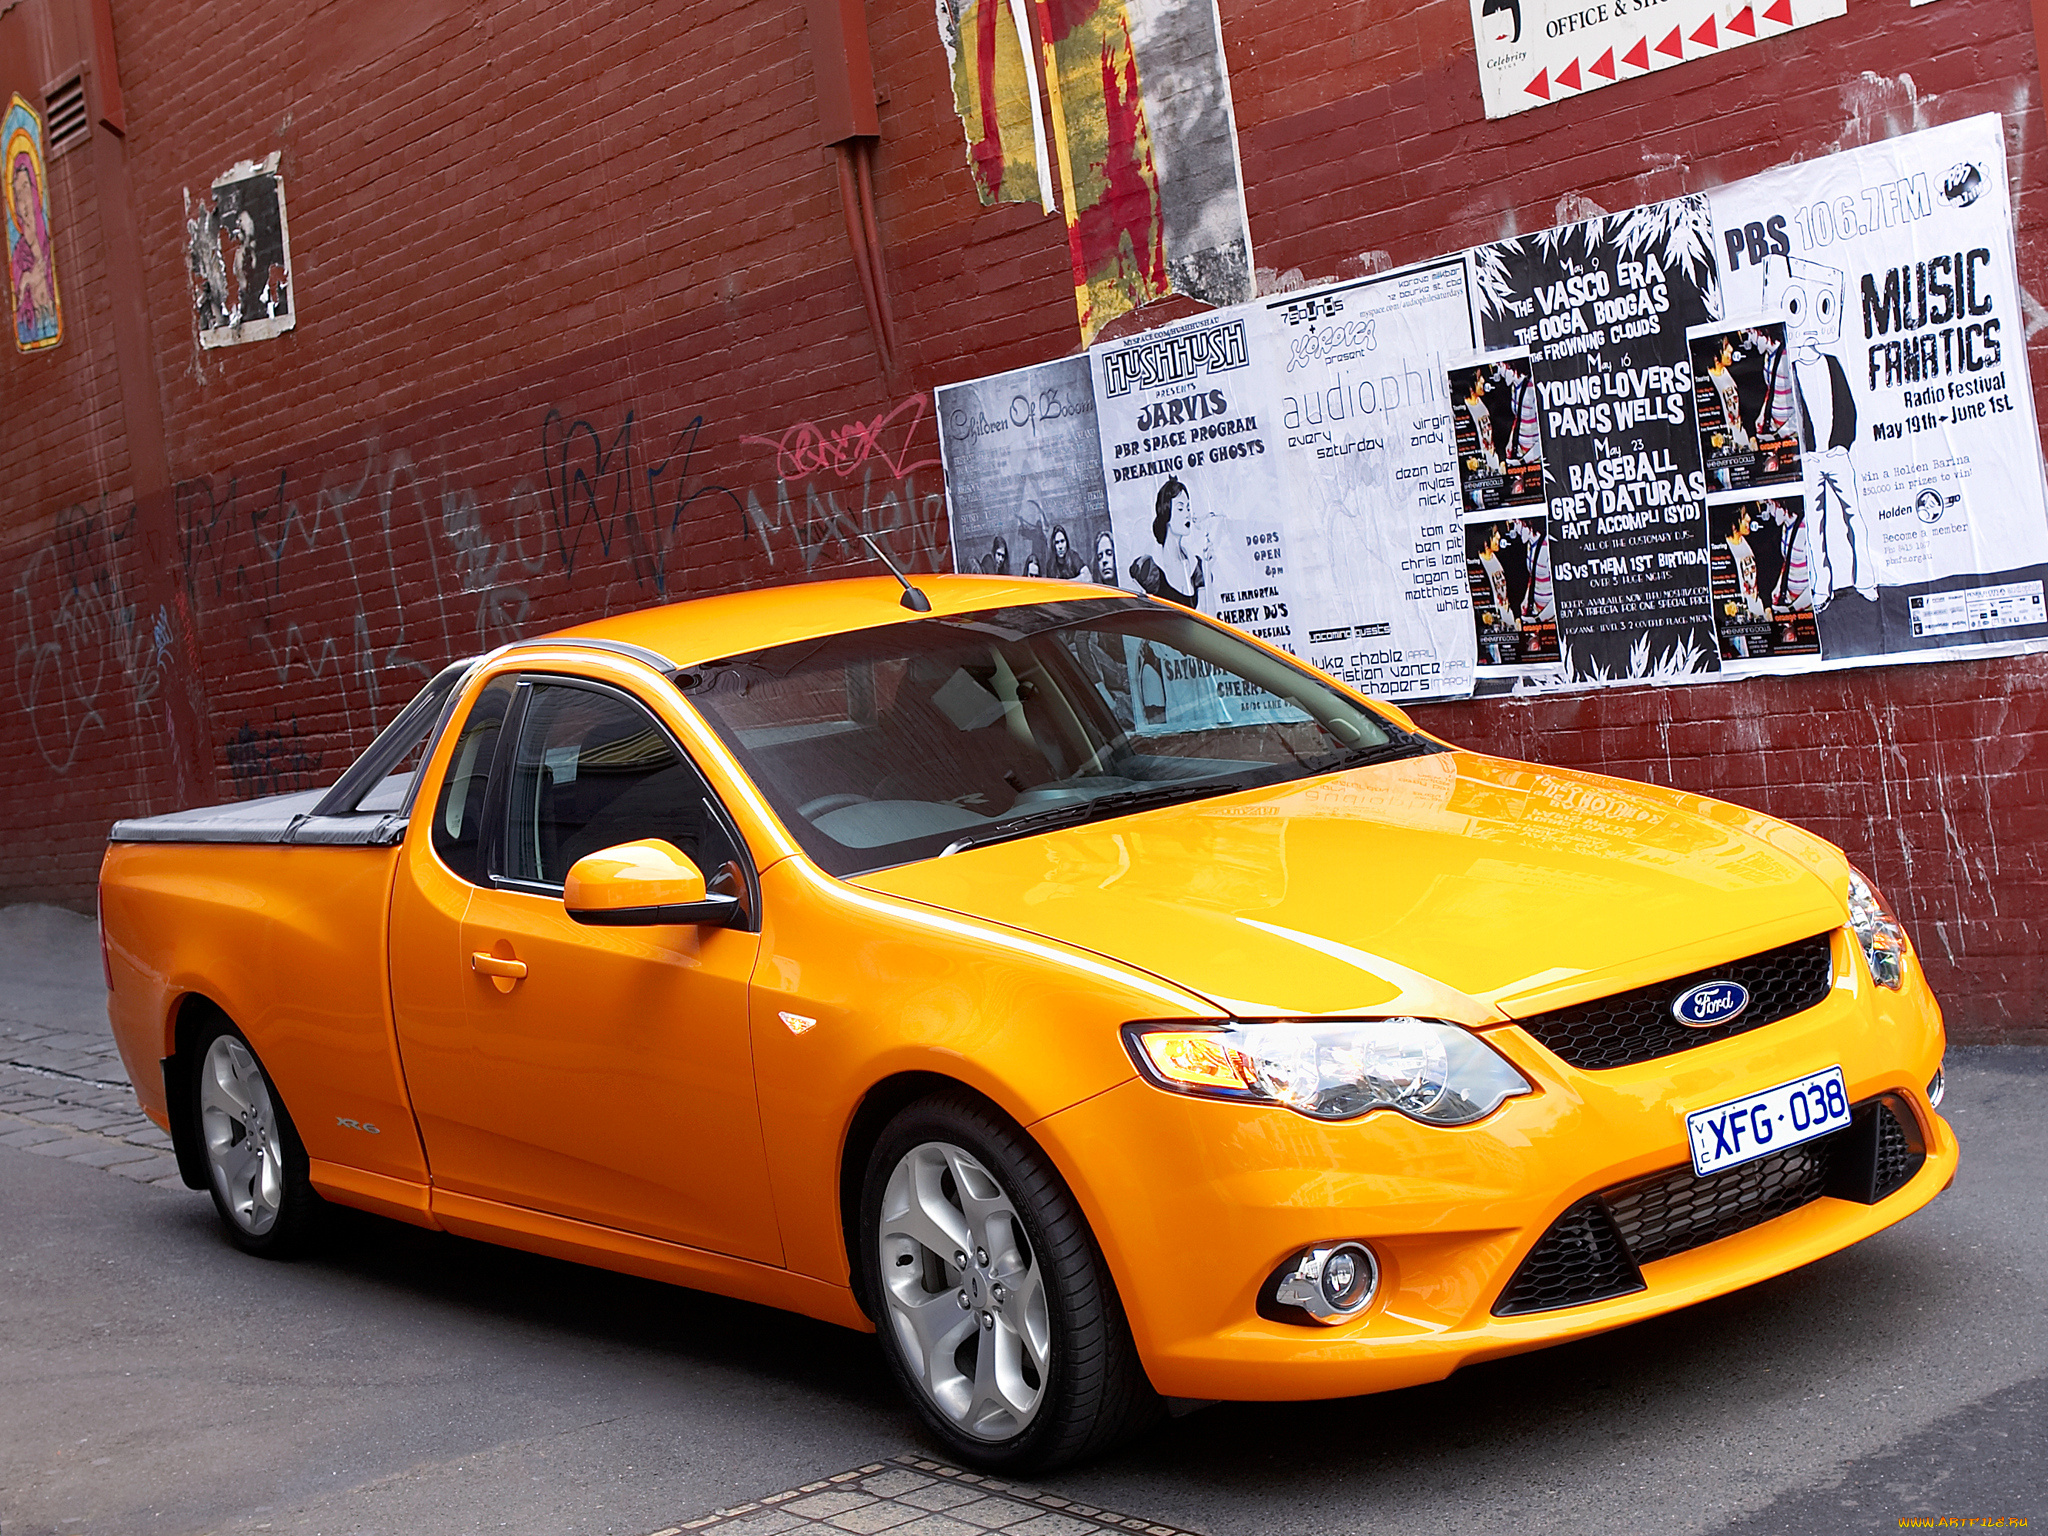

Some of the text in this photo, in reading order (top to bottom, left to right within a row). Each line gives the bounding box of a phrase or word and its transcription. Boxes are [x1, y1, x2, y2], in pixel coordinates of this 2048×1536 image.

[1546, 0, 1627, 38] OFFICE &
[1486, 50, 1528, 69] Celebrity
[1724, 171, 1932, 272] PBS 106.7FM
[1560, 256, 1600, 276] May 9
[1511, 253, 1667, 319] THE VASCO ERA
[1861, 248, 1994, 340] MUSIC
[1513, 283, 1670, 346] THE OOGA BOOGAS
[1543, 329, 1606, 361] FROWNING
[1610, 314, 1662, 344] CLOUDS
[1103, 319, 1249, 398] HUSHHUSH
[1324, 348, 1365, 366] present
[1587, 352, 1632, 374] May 16
[1868, 318, 2002, 391] FANATICS
[1155, 382, 1197, 399] PRESENTS
[1536, 361, 1692, 411] YOUNG LOVERS
[1904, 371, 2007, 408] Radio Festival
[950, 408, 1009, 447] Children
[1008, 394, 1037, 438] Of
[1137, 389, 1228, 432] JARVIS
[1548, 402, 1612, 438] PARIS
[1613, 393, 1685, 432] WELLS
[1872, 393, 2014, 442] May 19th June 1st
[1114, 415, 1258, 459] PBR SPACE PROGRAM
[1287, 430, 1332, 449] every
[1410, 431, 1444, 447] andy
[1593, 436, 1645, 460] May 23
[1316, 437, 1385, 460] saturday
[1112, 438, 1266, 483] DREAMING OF GHOSTS
[1568, 448, 1678, 491] BASEBALL
[1882, 470, 1890, 479] a
[1893, 462, 1930, 478] Holden
[1932, 455, 1971, 471] Barina
[1395, 466, 1429, 480] dean
[1418, 476, 1455, 492] myles
[1894, 481, 1906, 491] in
[1908, 475, 1939, 490] prizes
[1940, 472, 1951, 482] to
[1418, 492, 1447, 507] nick
[1550, 489, 1599, 523] GREY
[1601, 470, 1706, 514] DATURAS
[1561, 501, 1701, 540] FAIT ACCOMPLI (SYD)
[1878, 505, 1913, 521] Holden
[1245, 531, 1280, 546] DOORS
[1420, 525, 1444, 538] tom
[1628, 531, 1672, 547] CUSTOMARY
[1882, 531, 1918, 544] Become
[1931, 522, 1970, 537] member
[1253, 548, 1282, 562] OPEN
[1414, 541, 1441, 554] ben
[1401, 555, 1437, 571] chris
[1555, 561, 1573, 581] US
[1588, 555, 1628, 577] THEM
[1630, 554, 1654, 573] 1ST
[1657, 547, 1709, 568] BIRTHDAY
[1412, 570, 1450, 586] logan
[1220, 585, 1280, 604] THE IMMORTAL
[1404, 584, 1459, 601] matthias
[1216, 602, 1289, 625] CHERRY DJ'S
[1436, 598, 1469, 613] white
[1577, 608, 1584, 617] A
[1354, 622, 1392, 638] guests
[1311, 655, 1344, 671] luke
[1349, 649, 1403, 668] chable
[1389, 662, 1441, 678] vance
[1360, 678, 1430, 696] chapers
[1694, 988, 1734, 1018] Ford
[336, 1116, 381, 1134] XR6
